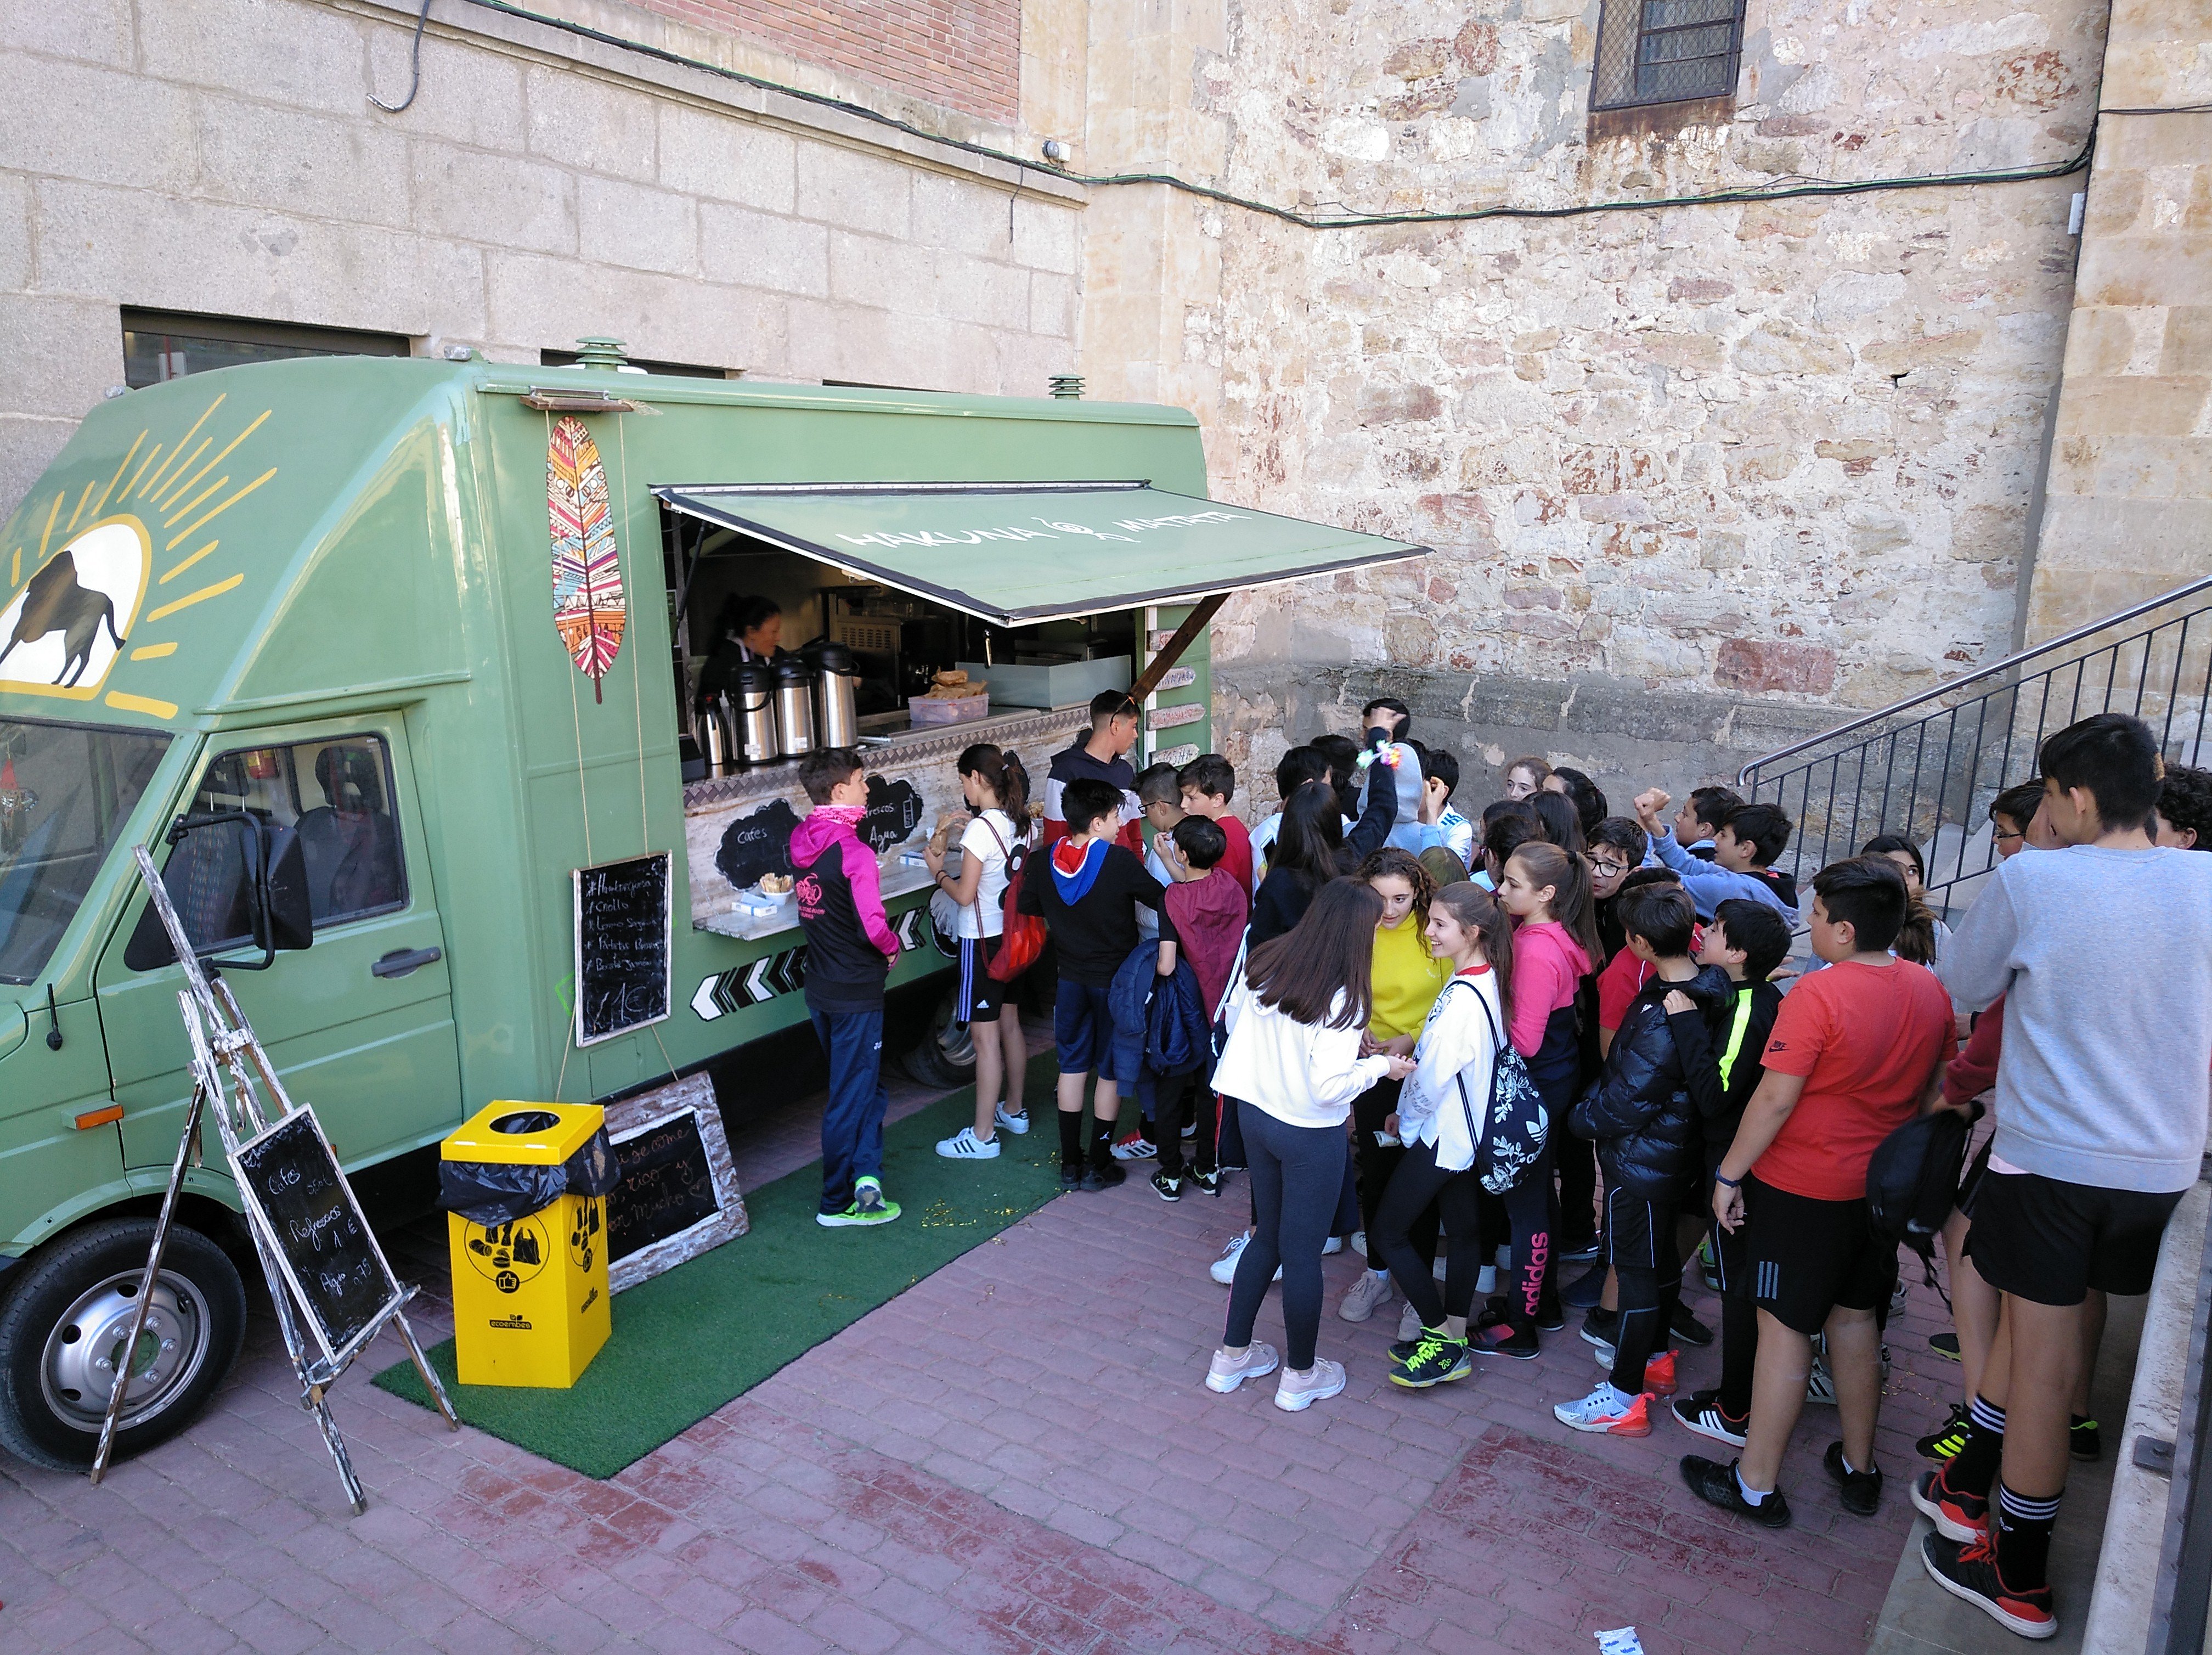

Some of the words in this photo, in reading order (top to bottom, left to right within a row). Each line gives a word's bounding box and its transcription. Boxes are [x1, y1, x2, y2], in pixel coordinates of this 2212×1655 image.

[835, 527, 1060, 548] HAKUNA
[1112, 511, 1252, 532] MATATA
[864, 803, 894, 818] frescos
[870, 825, 898, 853] Agua
[319, 1272, 346, 1298] Agua
[1521, 1232, 1549, 1316] adidas
